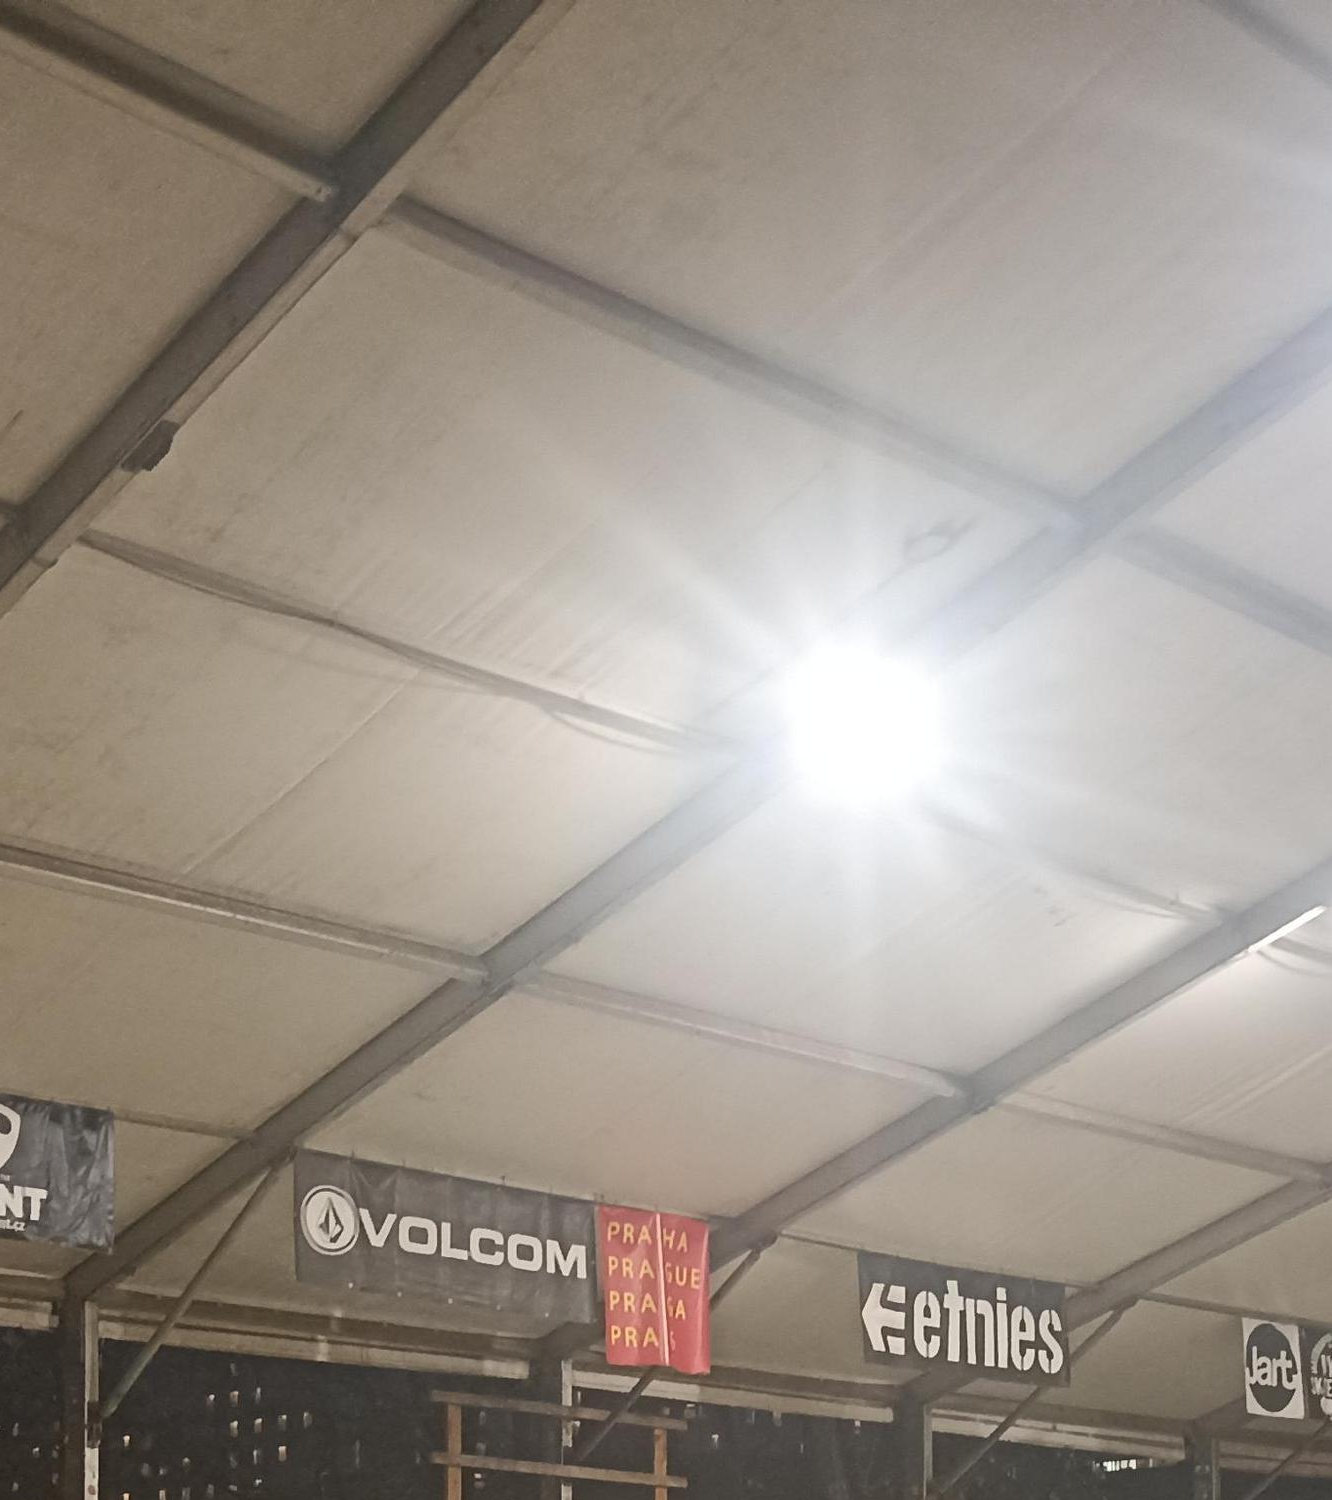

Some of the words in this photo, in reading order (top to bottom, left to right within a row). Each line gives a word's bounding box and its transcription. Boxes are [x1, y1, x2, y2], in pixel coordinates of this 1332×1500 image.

[359, 1207, 587, 1279] VOLCOM
[607, 1221, 688, 1252] PRAHA
[608, 1255, 701, 1289] PRAGUE
[913, 1279, 1064, 1374] etnies
[1245, 1345, 1299, 1390] Jart
